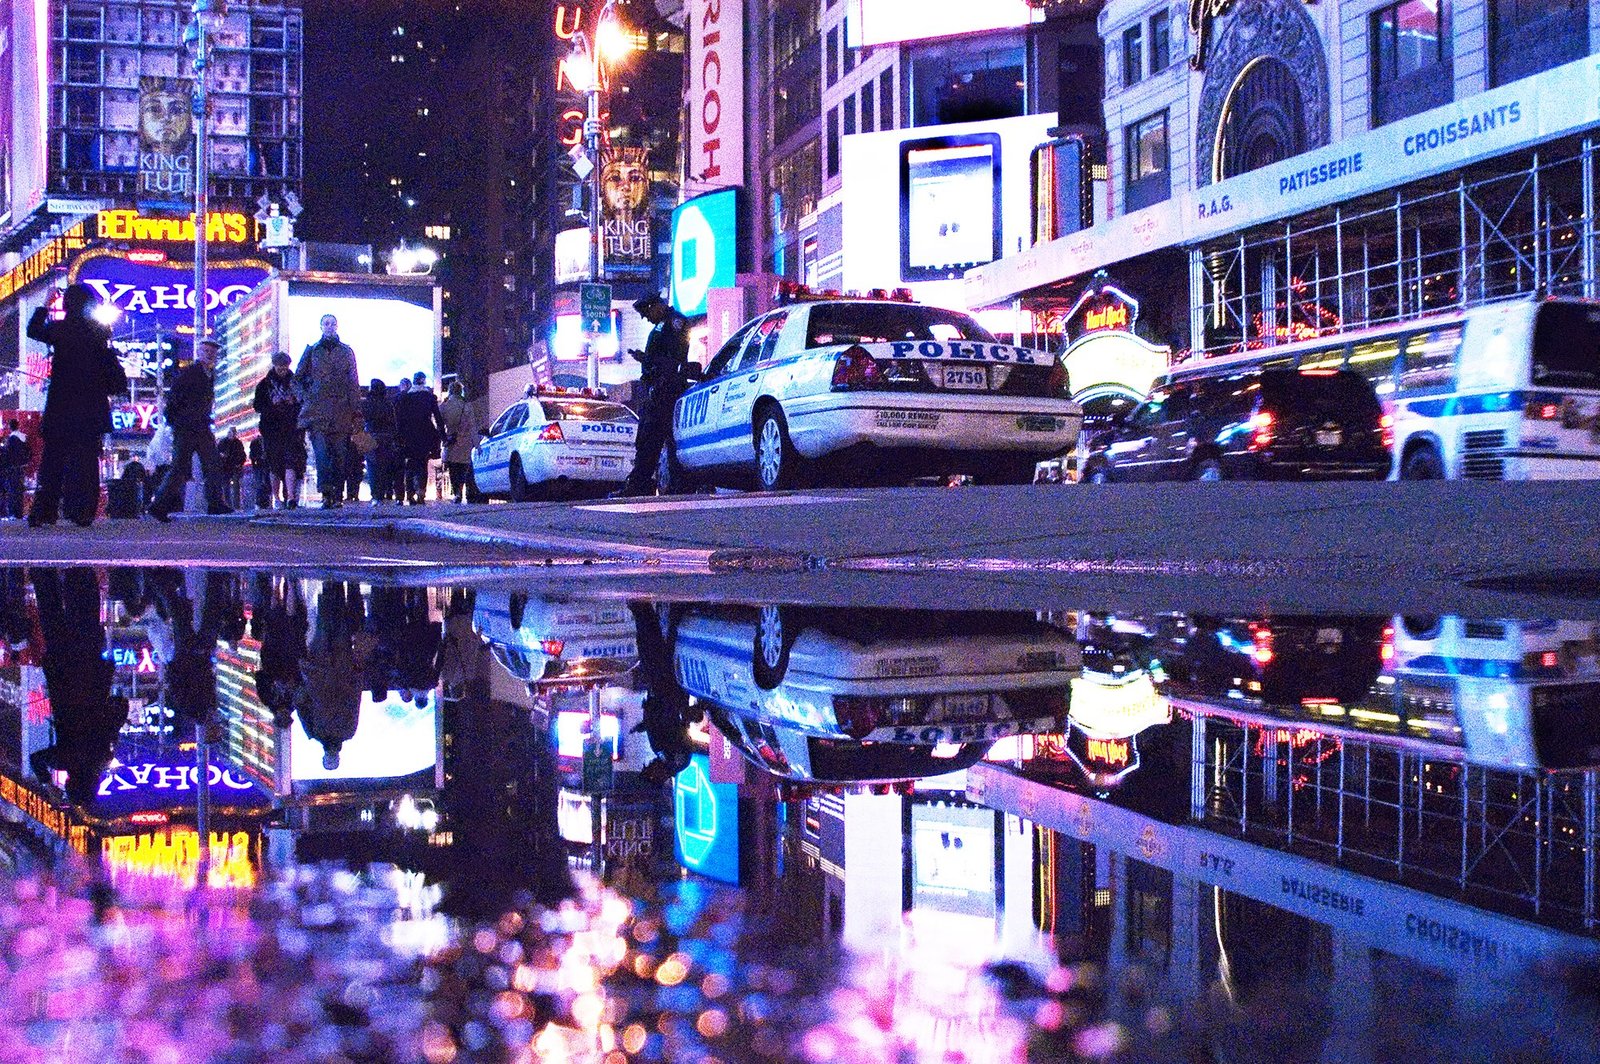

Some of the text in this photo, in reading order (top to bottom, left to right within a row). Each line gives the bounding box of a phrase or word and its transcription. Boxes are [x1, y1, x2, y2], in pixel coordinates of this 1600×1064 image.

[1404, 101, 1522, 157] CROISSANTS
[139, 153, 191, 172] KING
[1279, 152, 1363, 196] PATISSERIE
[139, 171, 194, 194] TUT
[1198, 194, 1233, 220] R.A.G.
[604, 219, 649, 236] KING
[604, 235, 651, 259] TUT
[890, 341, 1035, 364] POLICE
[946, 371, 983, 385] 2750
[581, 424, 634, 435] POLICE
